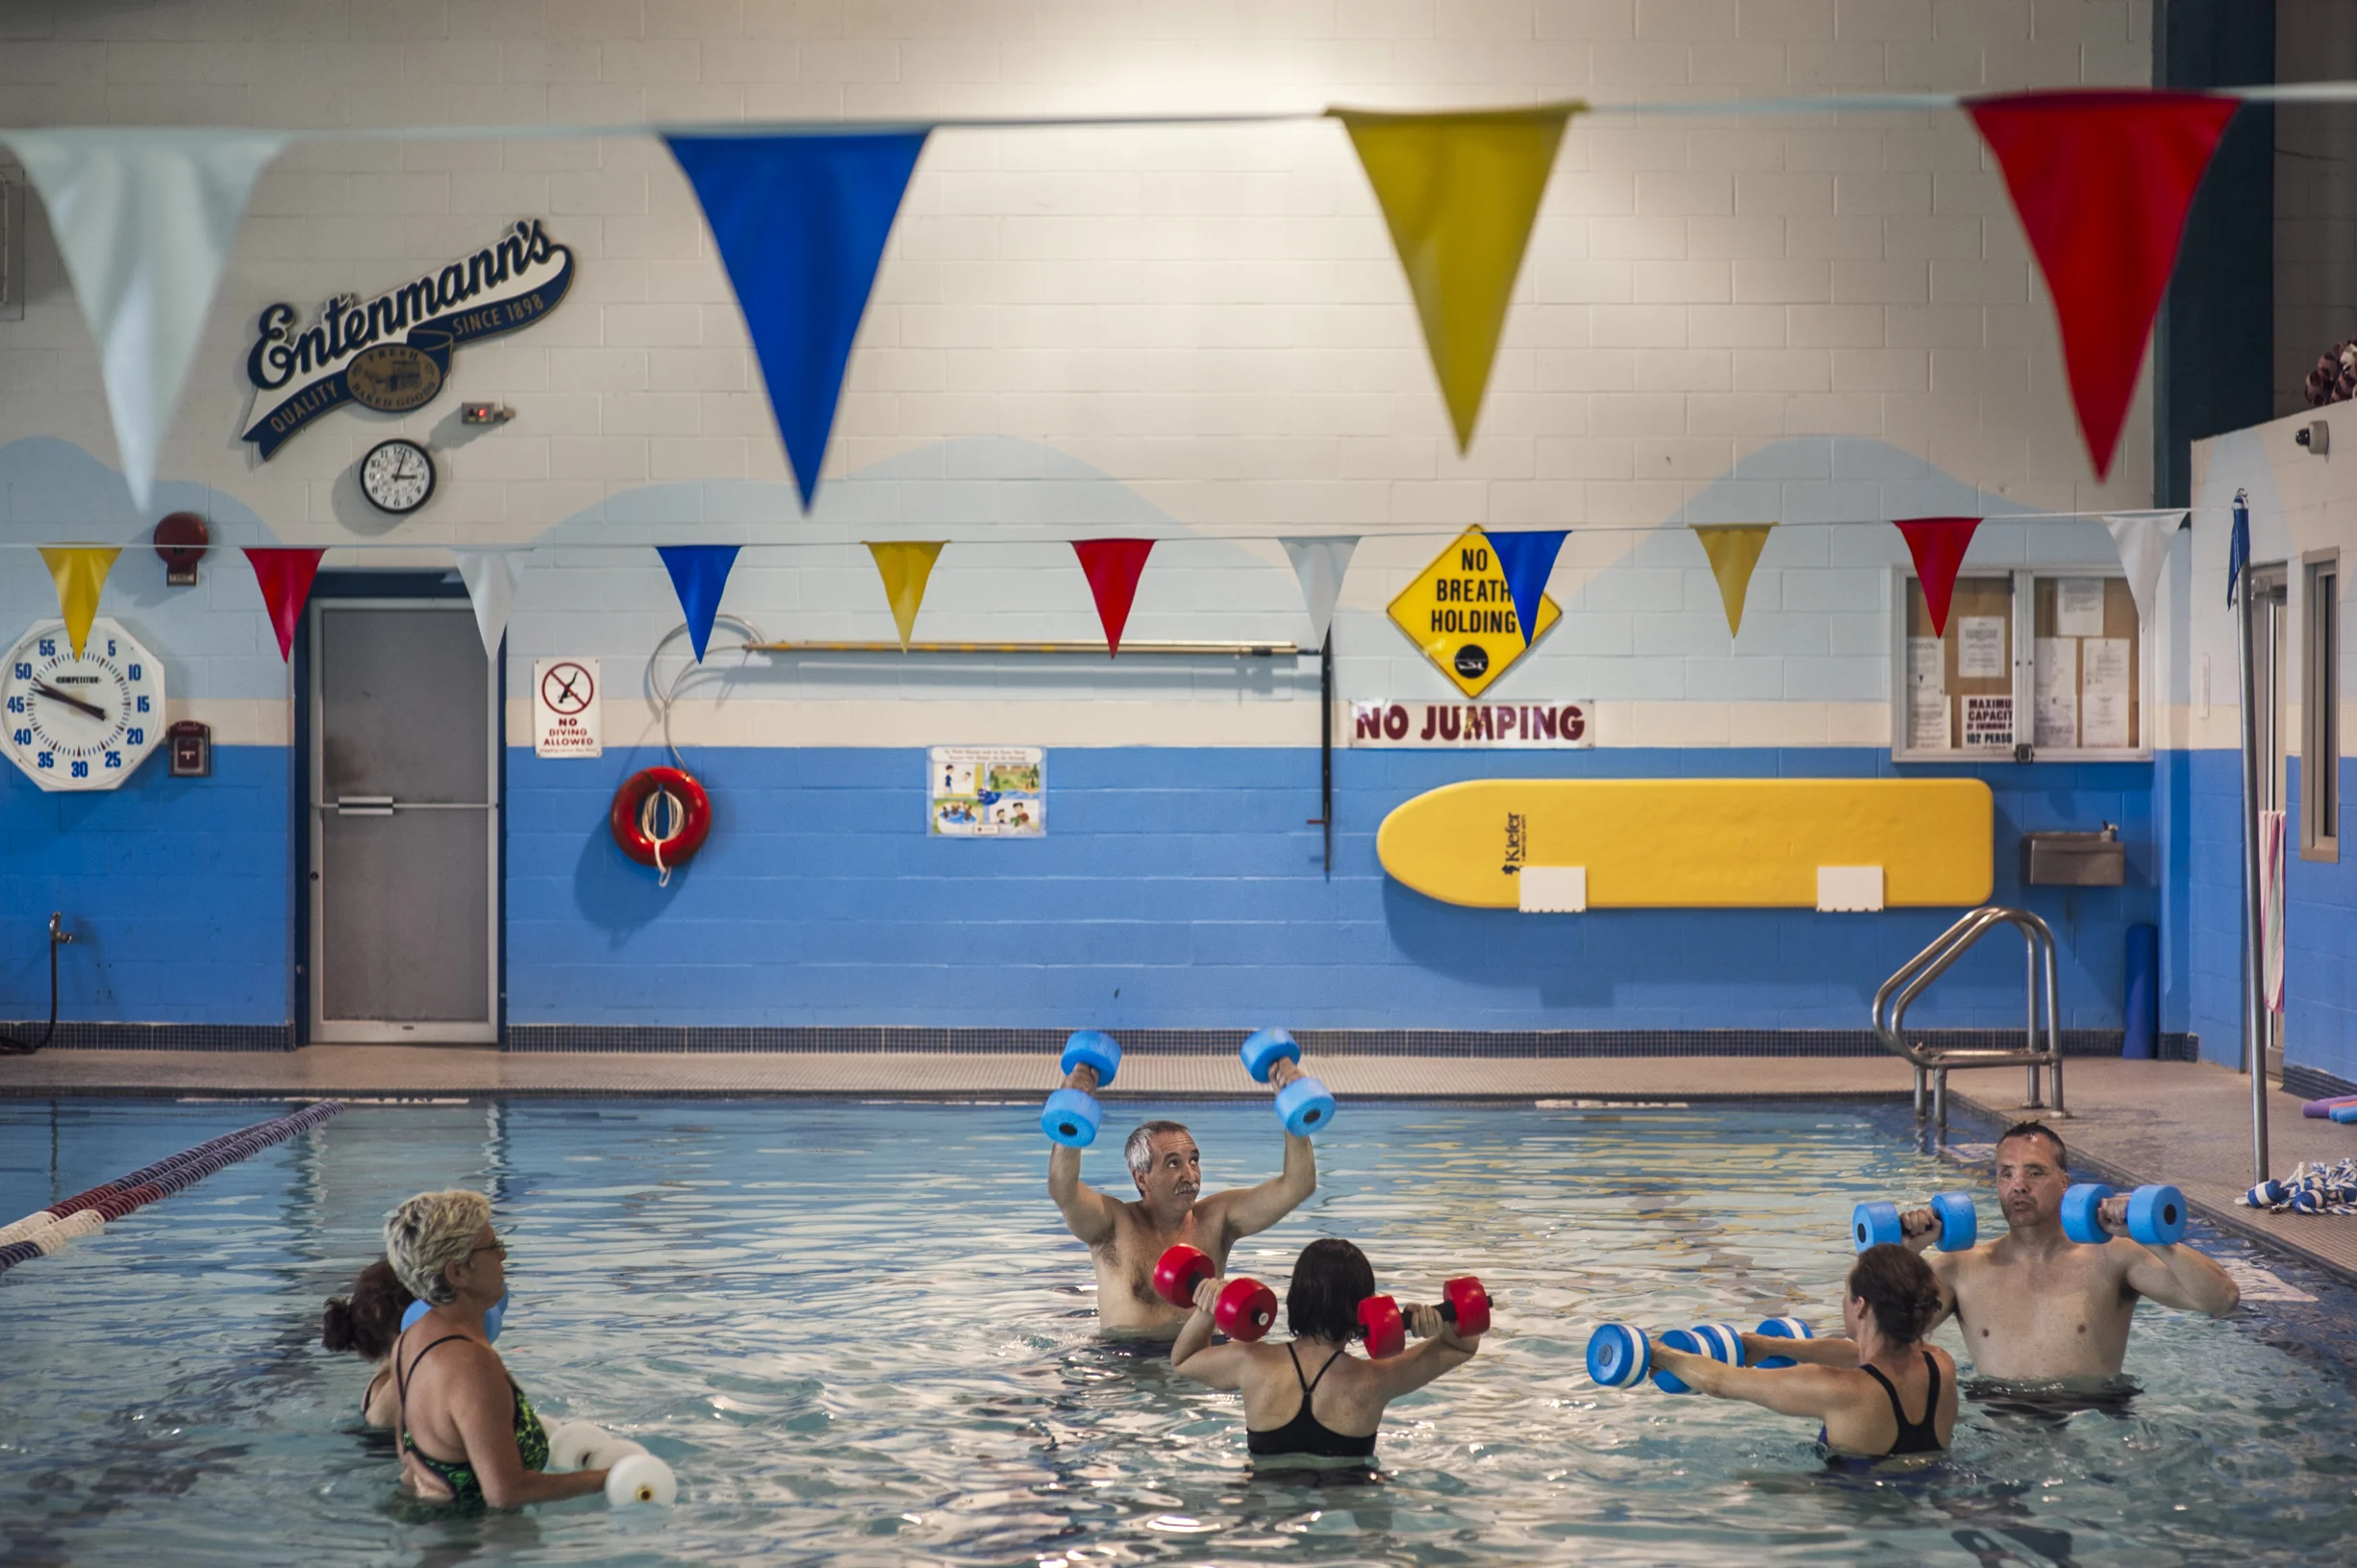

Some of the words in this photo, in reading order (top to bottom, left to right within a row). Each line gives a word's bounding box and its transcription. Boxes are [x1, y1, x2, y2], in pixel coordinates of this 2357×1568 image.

[247, 219, 551, 388] Entenmann's
[453, 309, 501, 336] SINCE
[506, 293, 544, 322] 1898
[270, 380, 339, 434] QUALITY
[1462, 548, 1488, 572] NO
[1437, 579, 1513, 603] BREATH
[1431, 610, 1517, 634] HOLDING
[39, 639, 56, 657] 55
[108, 640, 116, 657] 5
[15, 662, 32, 680] 50
[128, 663, 141, 681] 10
[7, 696, 25, 713] 45
[137, 695, 150, 712] 15
[1968, 698, 2013, 709] MAXIMU
[559, 718, 578, 727] NO
[1356, 705, 1409, 740] NO
[1420, 705, 1585, 741] JUMPING
[1968, 710, 2013, 721] CAPACIT
[13, 728, 32, 745] 40
[126, 728, 143, 744] 20
[549, 728, 588, 736] DIVING
[1967, 733, 1981, 743] 102
[1985, 733, 2013, 743] PERSO
[543, 737, 593, 746] ALLOWED
[38, 751, 55, 768] 35
[105, 751, 122, 768] 25
[71, 760, 88, 778] 30
